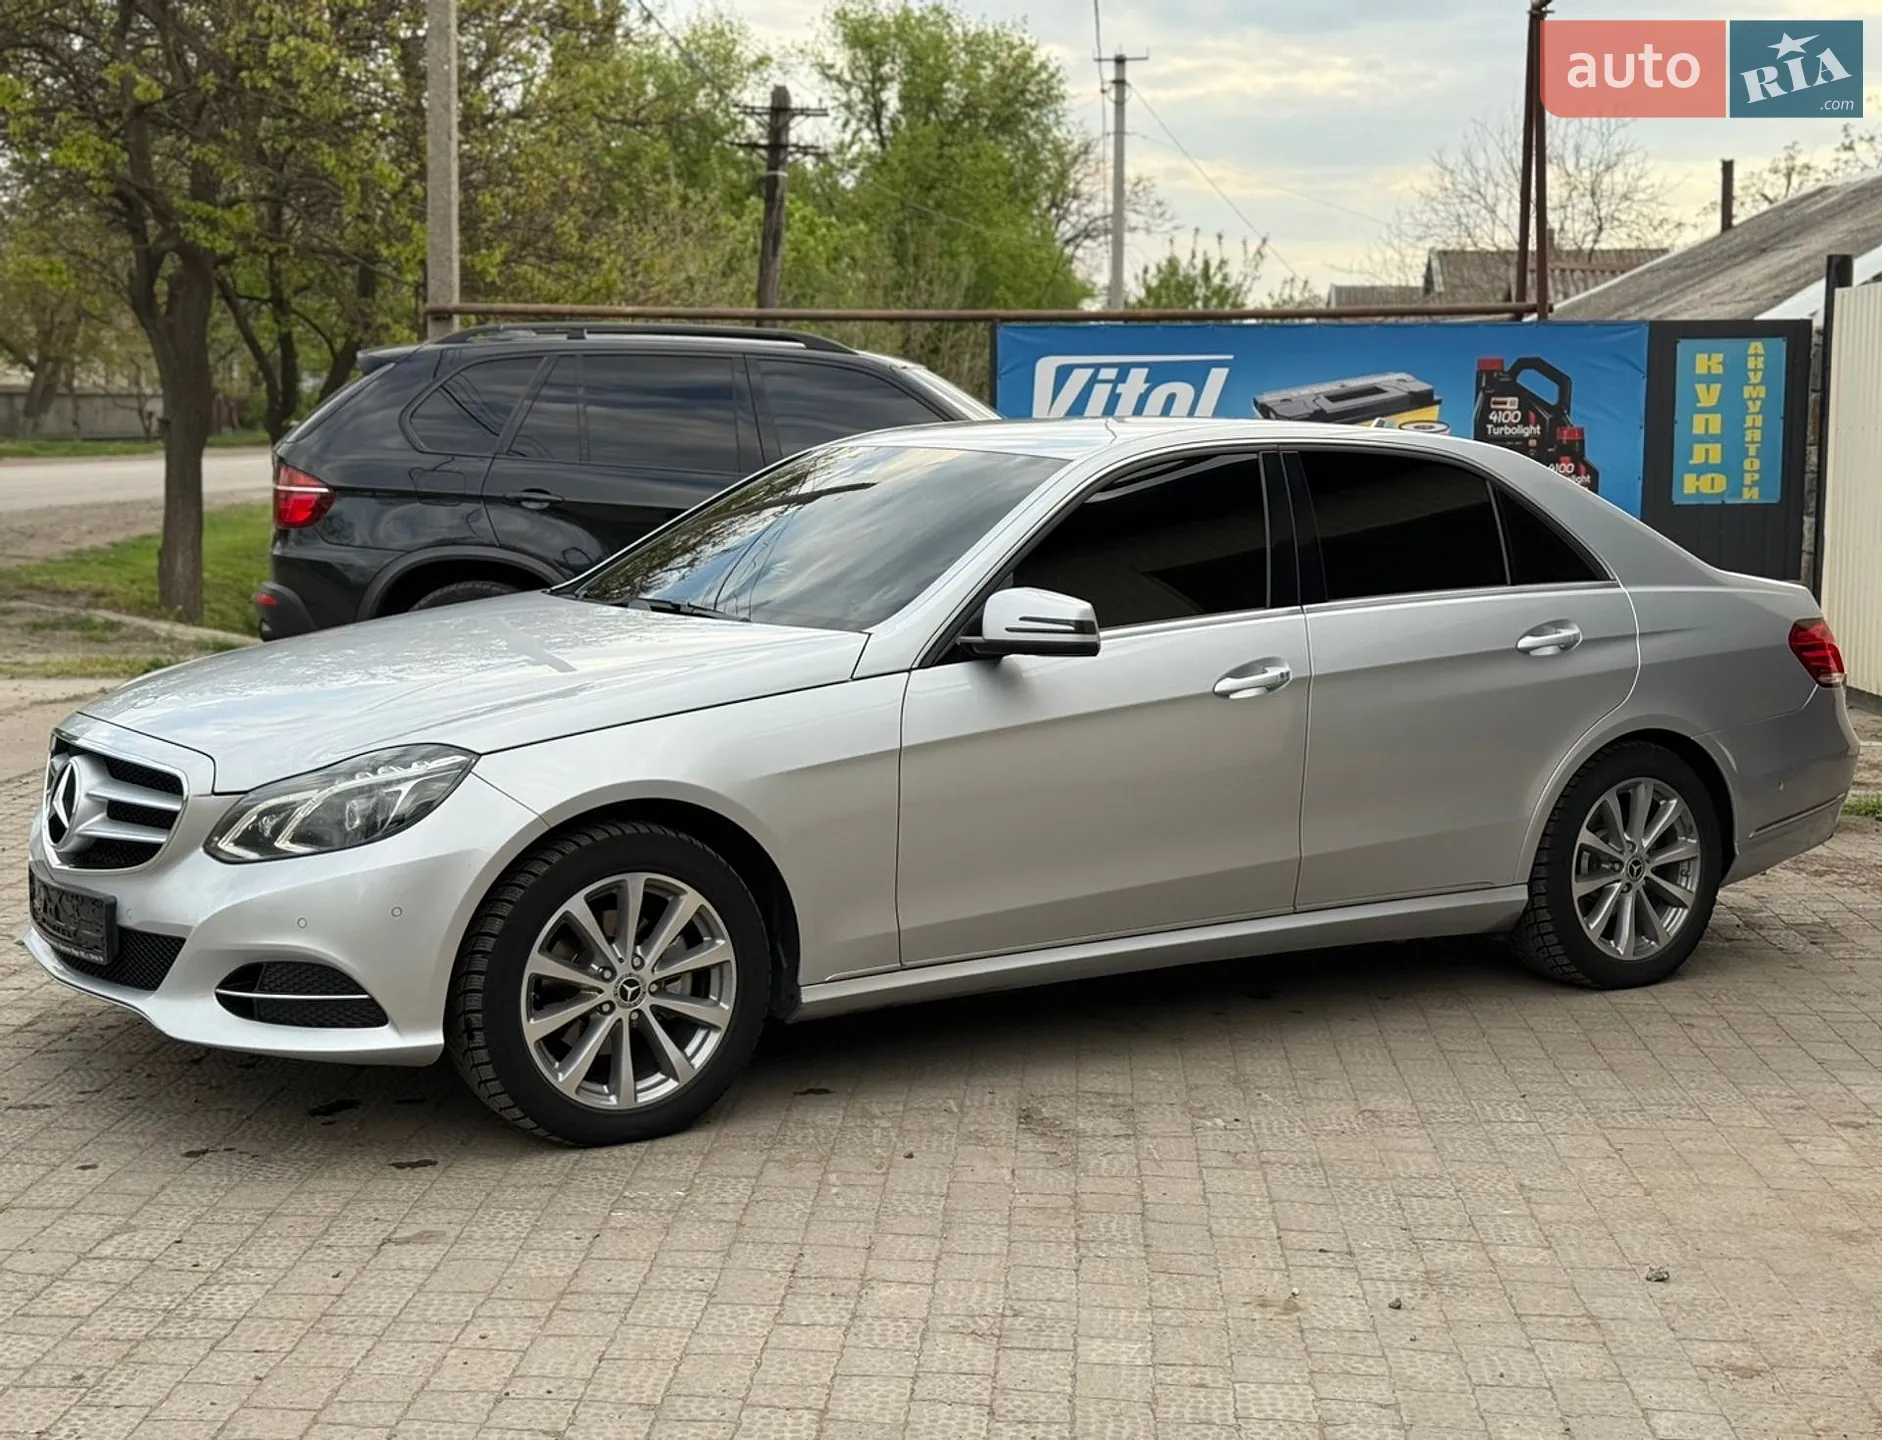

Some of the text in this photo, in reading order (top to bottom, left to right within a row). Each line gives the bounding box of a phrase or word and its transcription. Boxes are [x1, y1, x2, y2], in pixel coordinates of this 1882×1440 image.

[1032, 355, 1234, 418] Vitol
[1488, 410, 1522, 424] 4100
[1486, 424, 1541, 438] Turbolight
[1682, 353, 1728, 495] КУПЛЮ
[1742, 342, 1766, 499] АКУМУЛЯТОРИ
